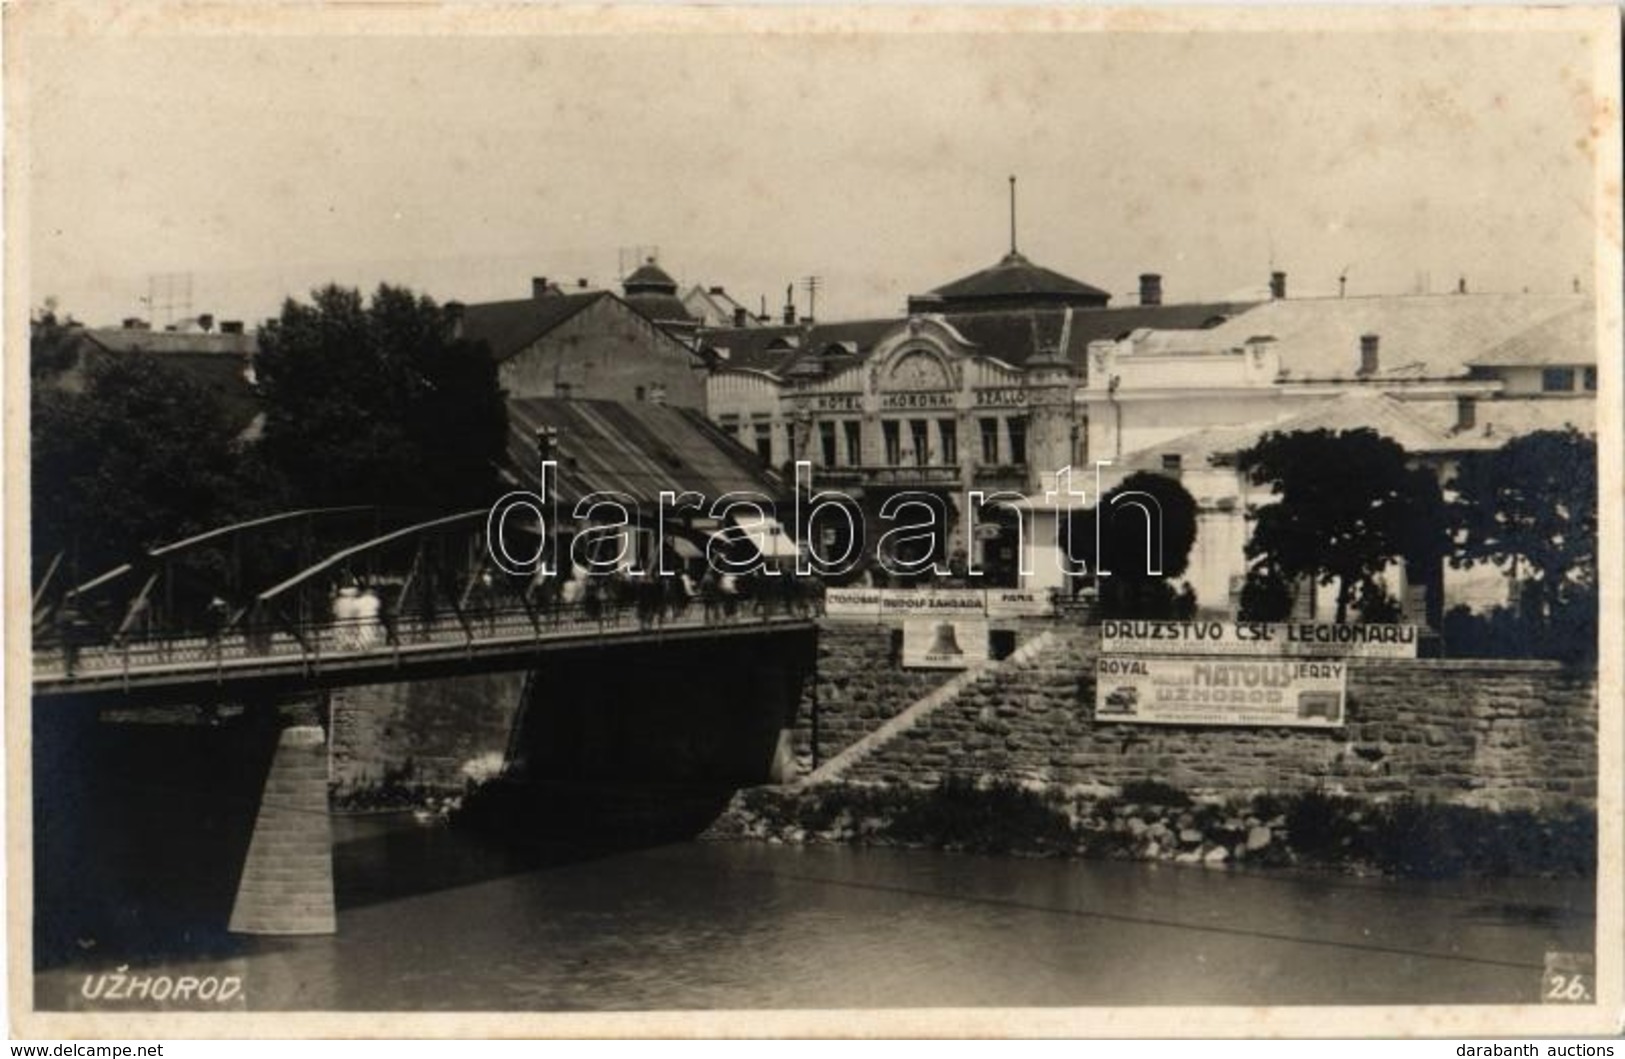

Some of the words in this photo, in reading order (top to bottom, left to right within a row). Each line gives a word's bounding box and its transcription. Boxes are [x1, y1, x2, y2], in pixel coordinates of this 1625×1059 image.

[817, 396, 862, 409] HOTEL
[1099, 659, 1150, 676] ROYAL
[1293, 663, 1343, 680] JERRY
